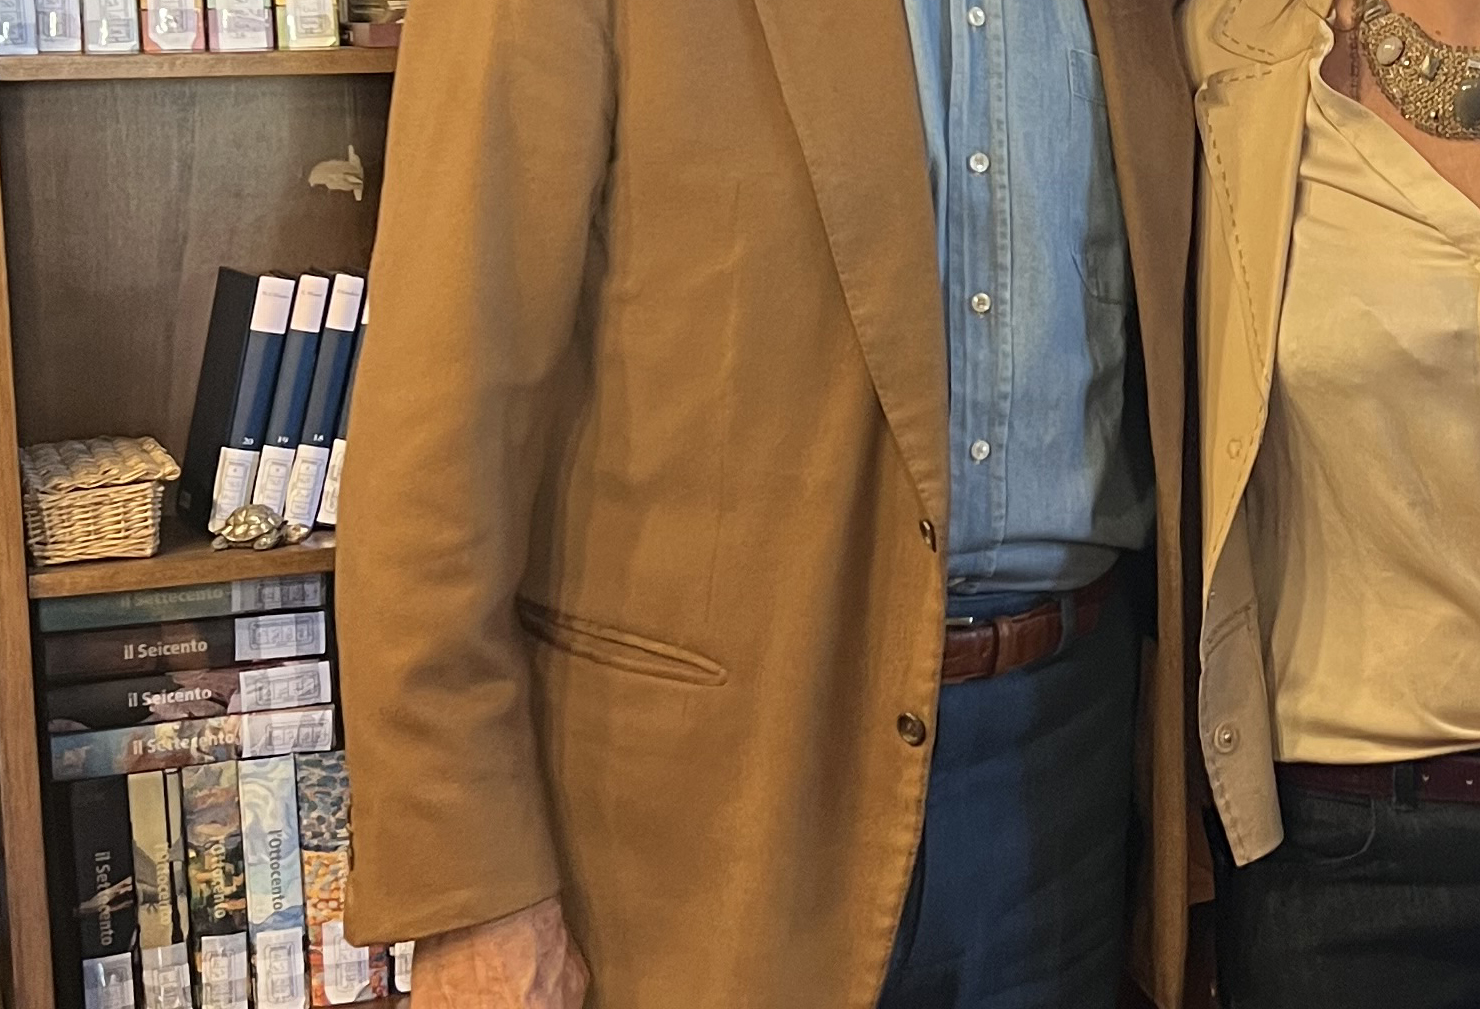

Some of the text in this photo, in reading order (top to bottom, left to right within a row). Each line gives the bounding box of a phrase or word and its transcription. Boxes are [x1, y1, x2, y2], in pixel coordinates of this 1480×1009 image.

[135, 586, 226, 607] Settecento
[137, 637, 208, 659] Seicento
[142, 686, 212, 707] Seicento
[147, 731, 236, 753] Settecento
[267, 829, 284, 911] l'Ottocento
[96, 863, 116, 947] Settecento
